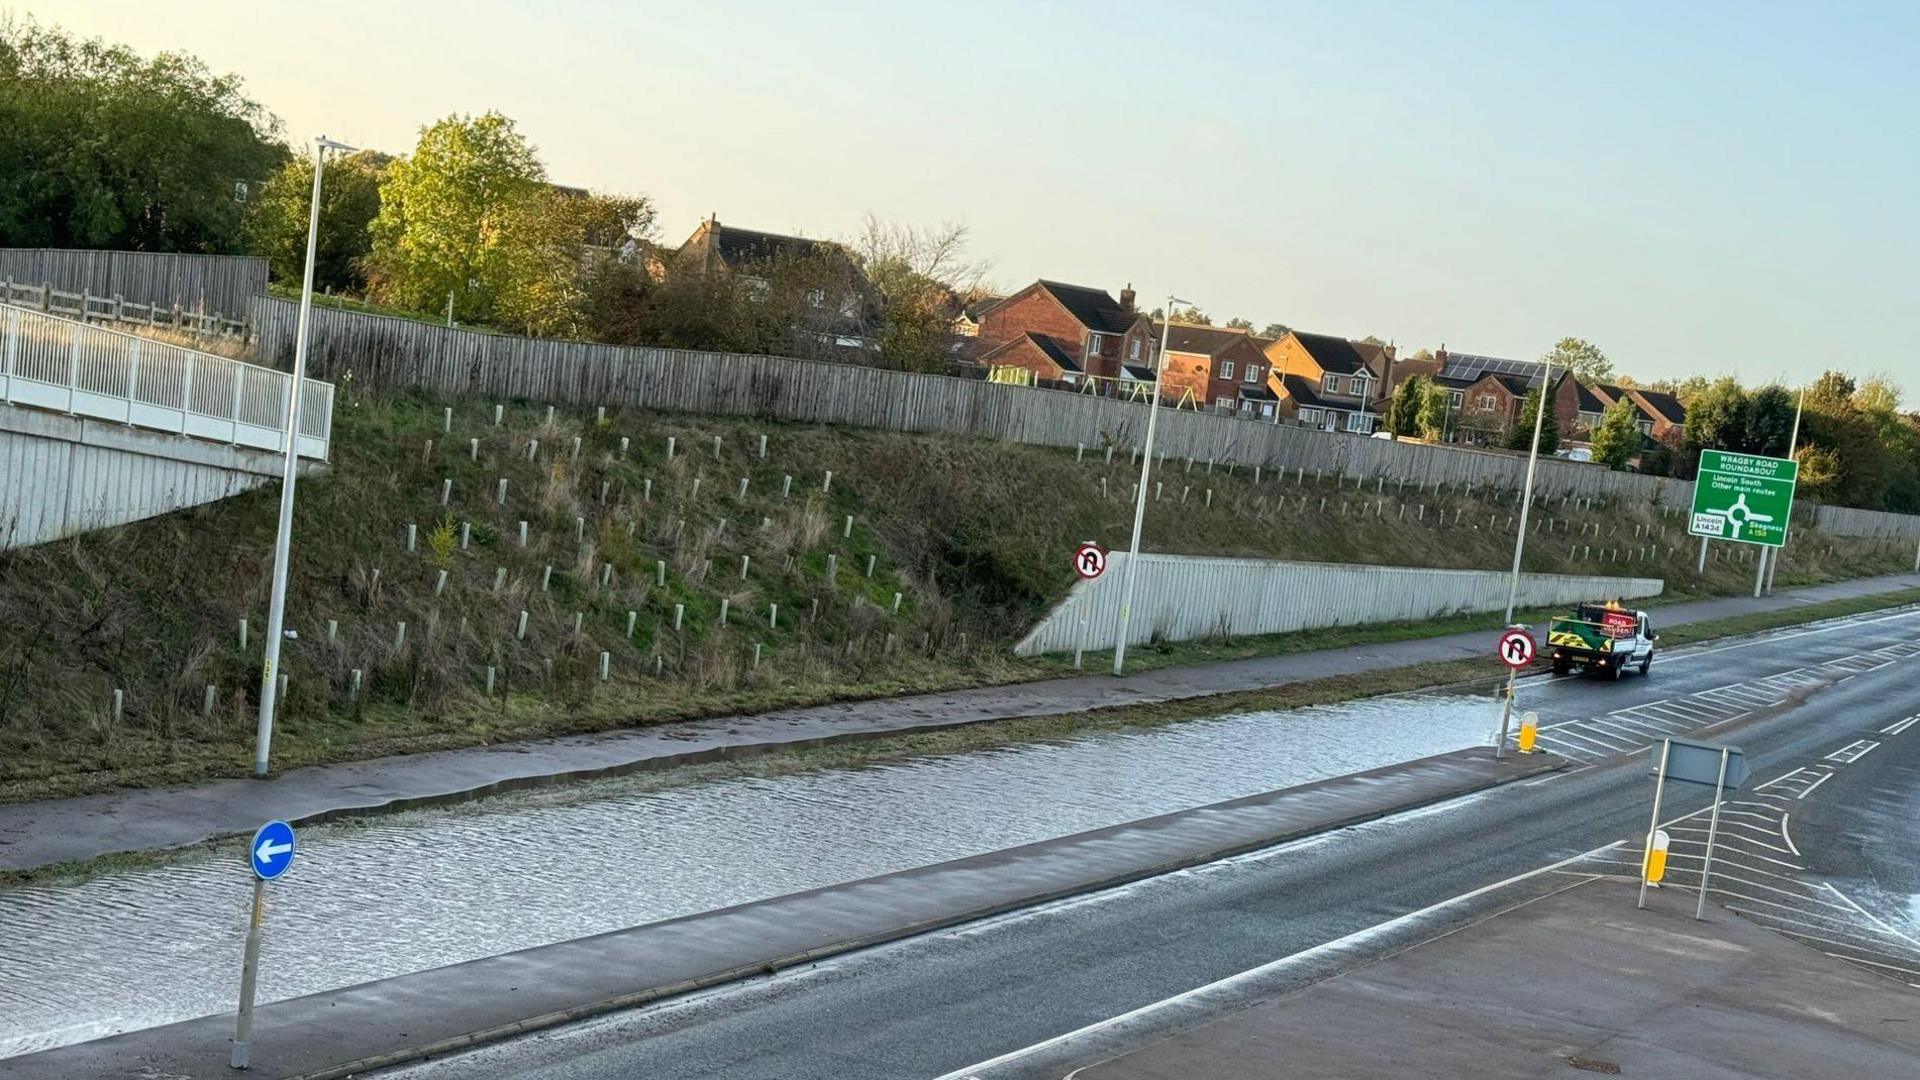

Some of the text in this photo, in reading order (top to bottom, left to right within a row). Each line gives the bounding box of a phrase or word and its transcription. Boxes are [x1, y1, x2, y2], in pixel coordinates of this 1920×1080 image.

[1720, 455, 1779, 469] WRAGBY ROAD
[1720, 463, 1776, 476] ROUNDABOUT
[1713, 474, 1762, 487] Lincoln South
[1712, 481, 1776, 496] Other main routes
[1696, 515, 1722, 524] Lincoln
[1749, 521, 1783, 532] Skegness
